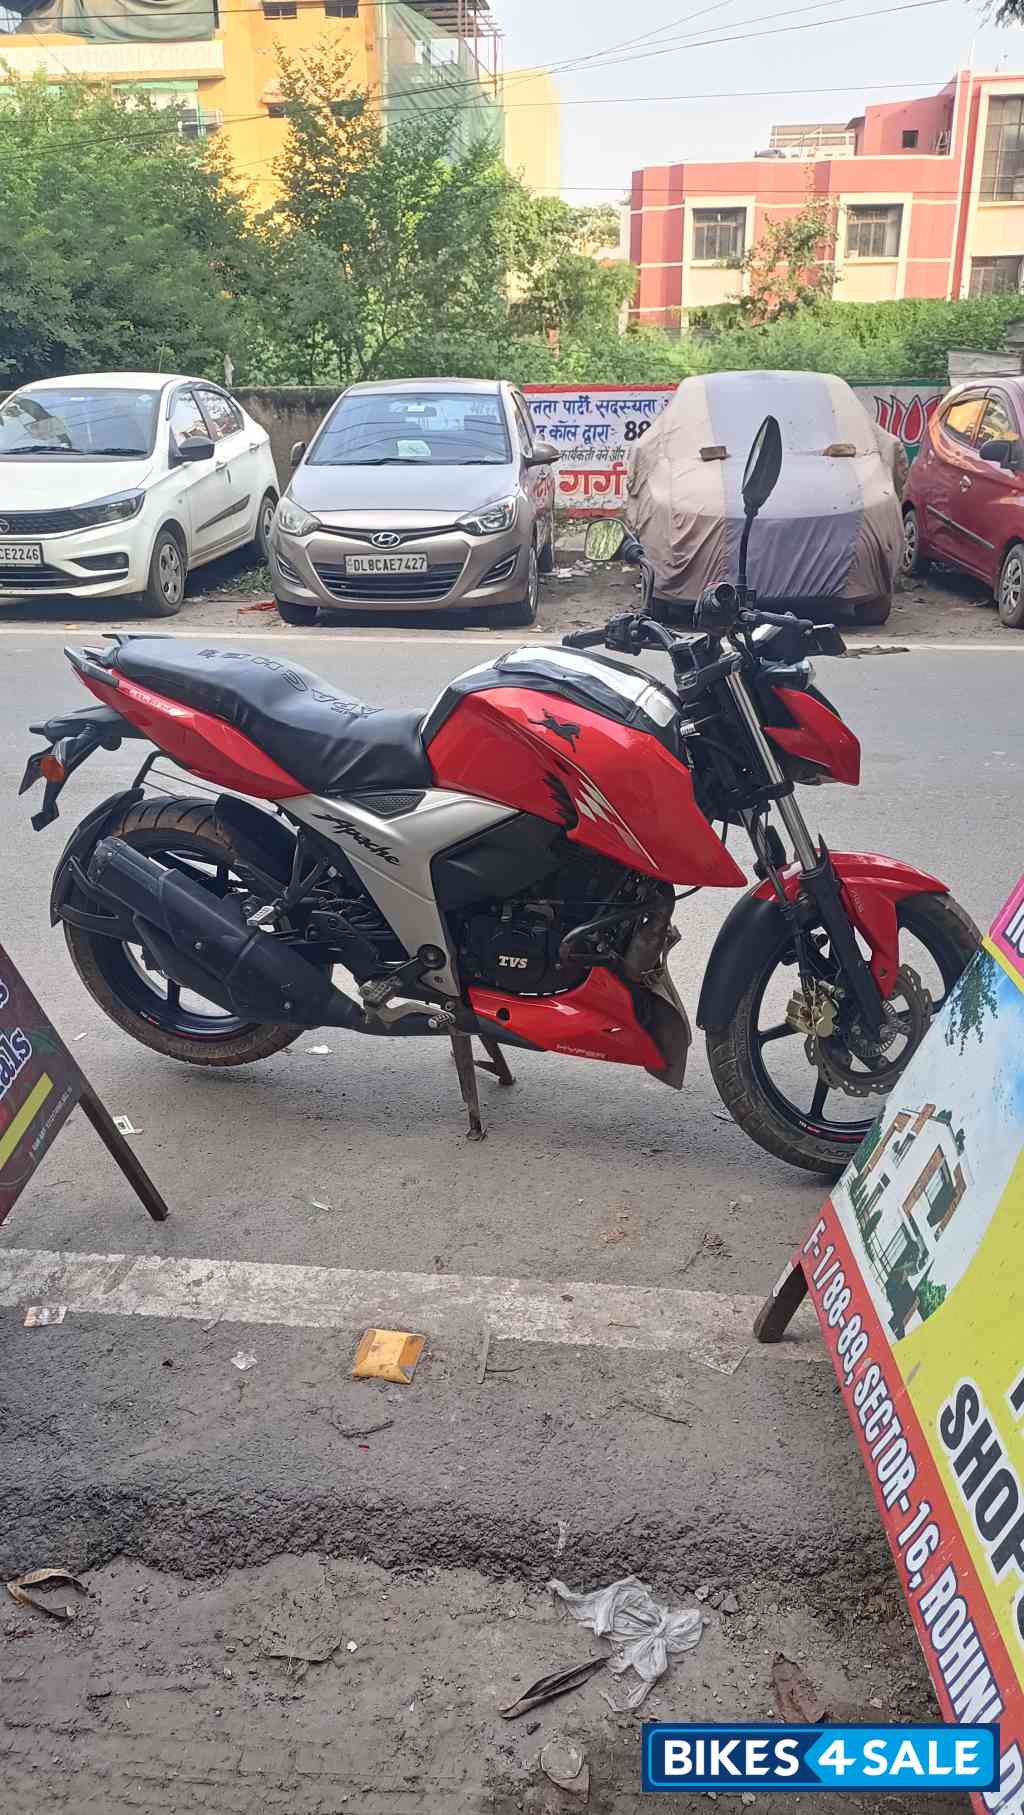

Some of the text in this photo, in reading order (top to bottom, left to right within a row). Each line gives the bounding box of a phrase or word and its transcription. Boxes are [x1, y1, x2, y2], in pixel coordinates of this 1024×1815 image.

[527, 399, 558, 419] नता
[559, 462, 628, 496] गर्ग
[353, 557, 425, 572] DL8CAE7427
[311, 812, 400, 866] Apache
[498, 954, 529, 969] TVS
